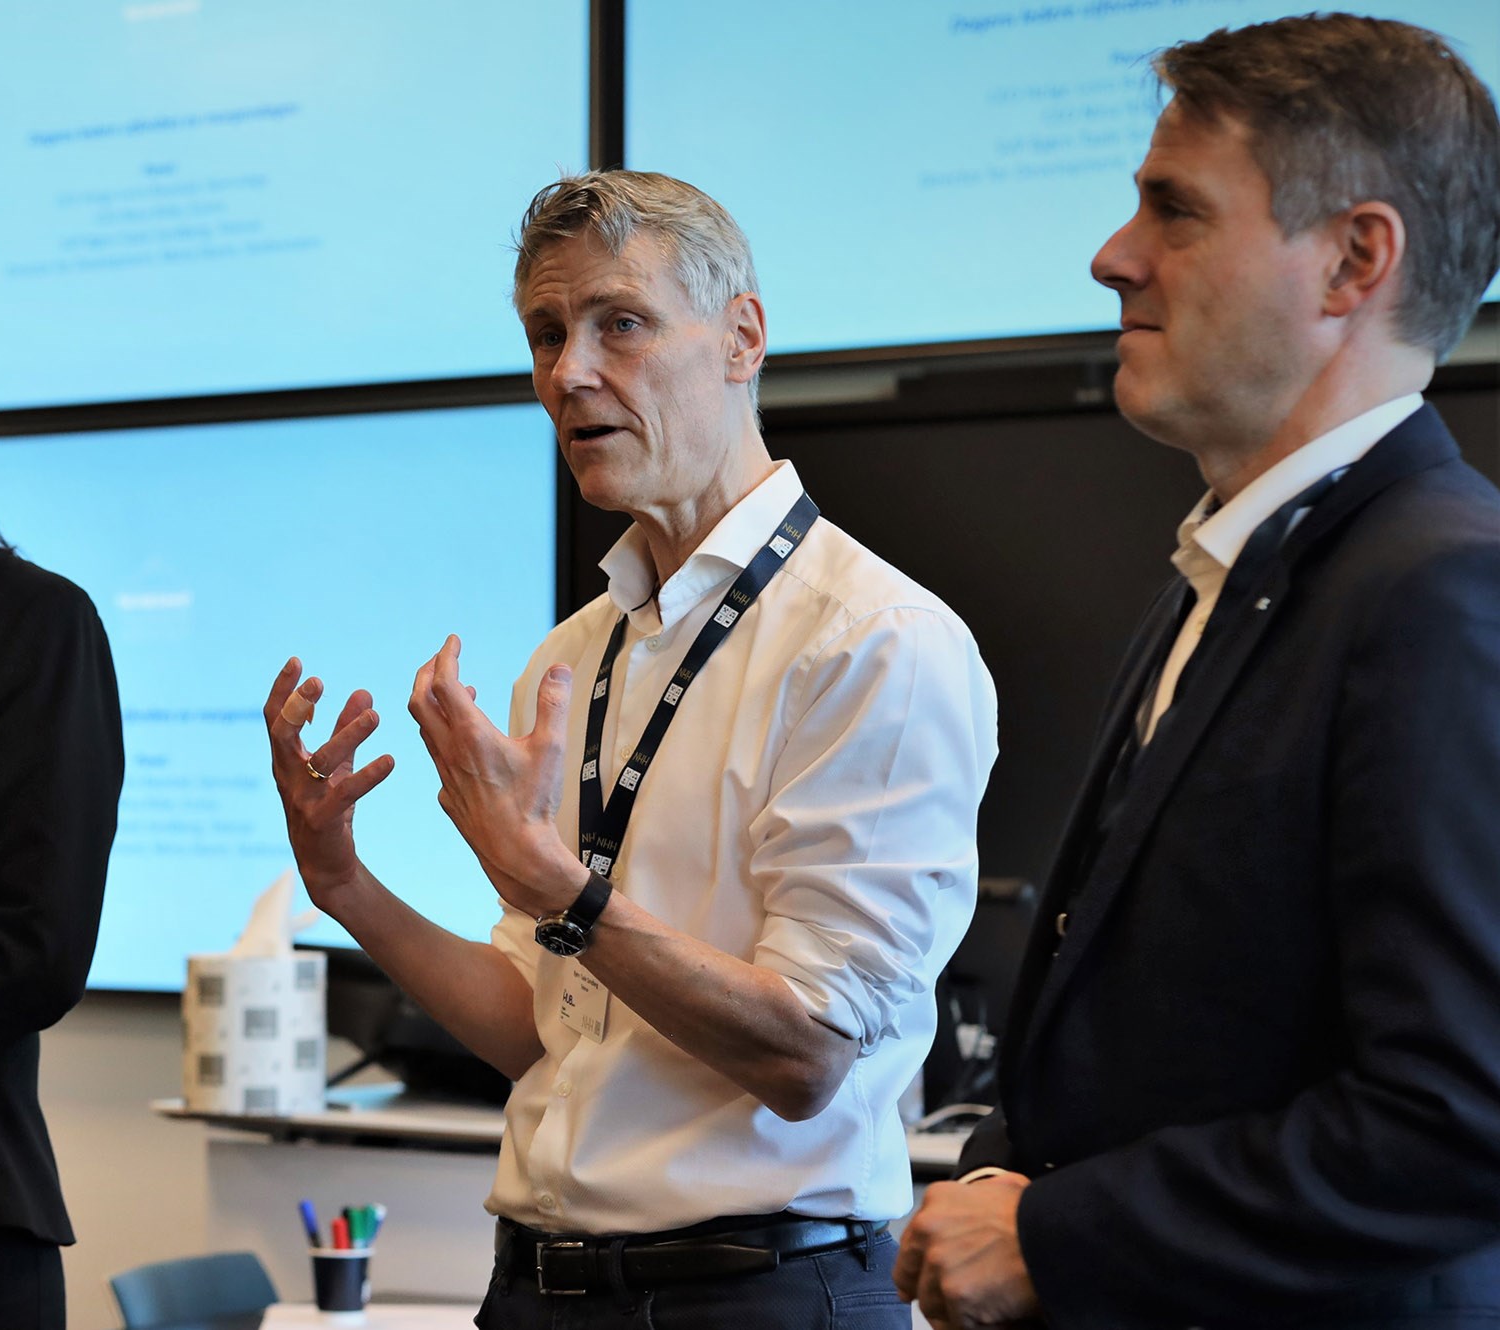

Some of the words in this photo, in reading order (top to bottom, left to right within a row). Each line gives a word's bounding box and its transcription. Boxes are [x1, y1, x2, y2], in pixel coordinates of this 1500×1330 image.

[782, 522, 802, 540] NHH
[730, 588, 751, 606] NHH
[677, 667, 694, 681] NHH
[581, 832, 596, 843] NH
[596, 836, 618, 851] NHH
